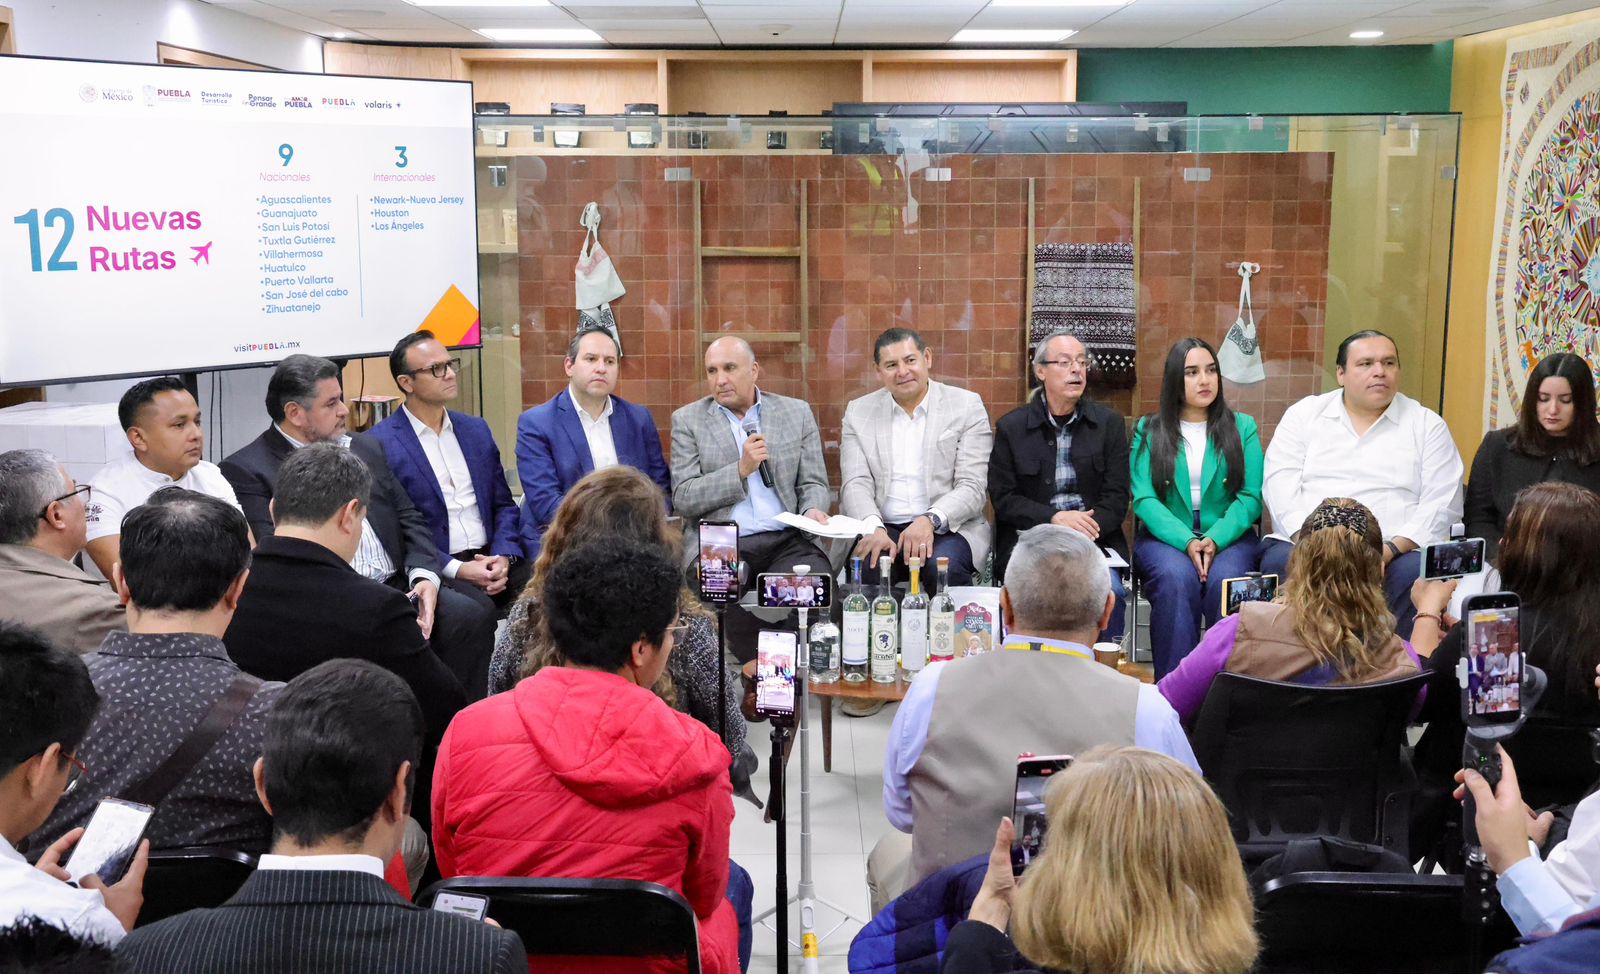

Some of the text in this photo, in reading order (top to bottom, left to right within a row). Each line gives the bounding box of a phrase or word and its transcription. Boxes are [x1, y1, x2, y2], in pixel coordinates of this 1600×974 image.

[102, 92, 133, 101] México
[157, 89, 191, 98] PUEBLA
[248, 94, 273, 102] Pensar
[322, 98, 356, 106] PUEBLA
[364, 100, 392, 109] volaris
[278, 143, 294, 167] 9
[394, 146, 408, 168] 3
[259, 172, 311, 182] Nacionales
[373, 172, 436, 182] Internacionales
[260, 195, 332, 206] Aguascalientes
[374, 196, 465, 206] Newark-Nueva Jersey
[86, 205, 202, 231] Nuevas
[261, 208, 318, 220] Guanajuato
[374, 208, 410, 218] Houston
[262, 220, 330, 232] San Luis Potosí
[375, 220, 424, 232] Los Ángeles
[14, 207, 78, 272] 12
[262, 234, 336, 246] Tuxtla Gutiérrez
[89, 246, 177, 272] Rutas
[263, 250, 323, 260] Villahermosa
[264, 263, 306, 273] Huatulco
[264, 275, 334, 288] Puerto Vallarta
[265, 287, 349, 300] San José del cabo
[266, 303, 321, 314] Zihuatanejo
[234, 341, 301, 352] visitPUEBLA.mx
